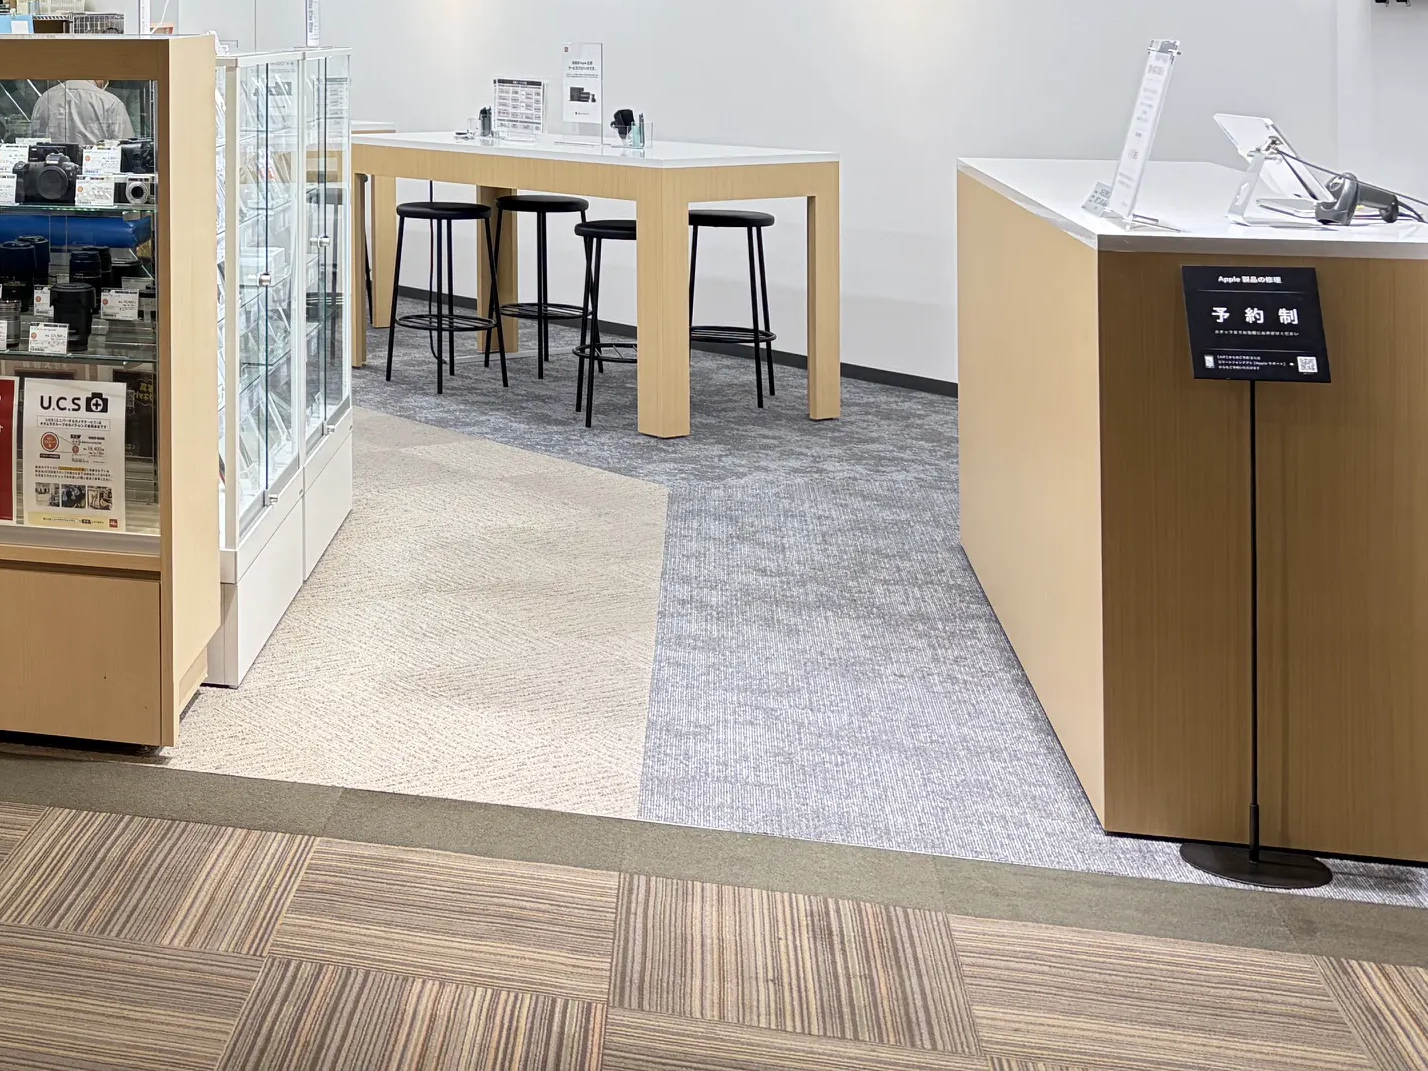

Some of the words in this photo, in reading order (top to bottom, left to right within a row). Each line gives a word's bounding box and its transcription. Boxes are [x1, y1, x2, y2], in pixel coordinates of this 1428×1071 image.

[1218, 276, 1241, 284] Apple
[1241, 276, 1282, 284] 製品の修理
[1211, 307, 1299, 325] 予約制
[39, 395, 82, 412] U.C.S
